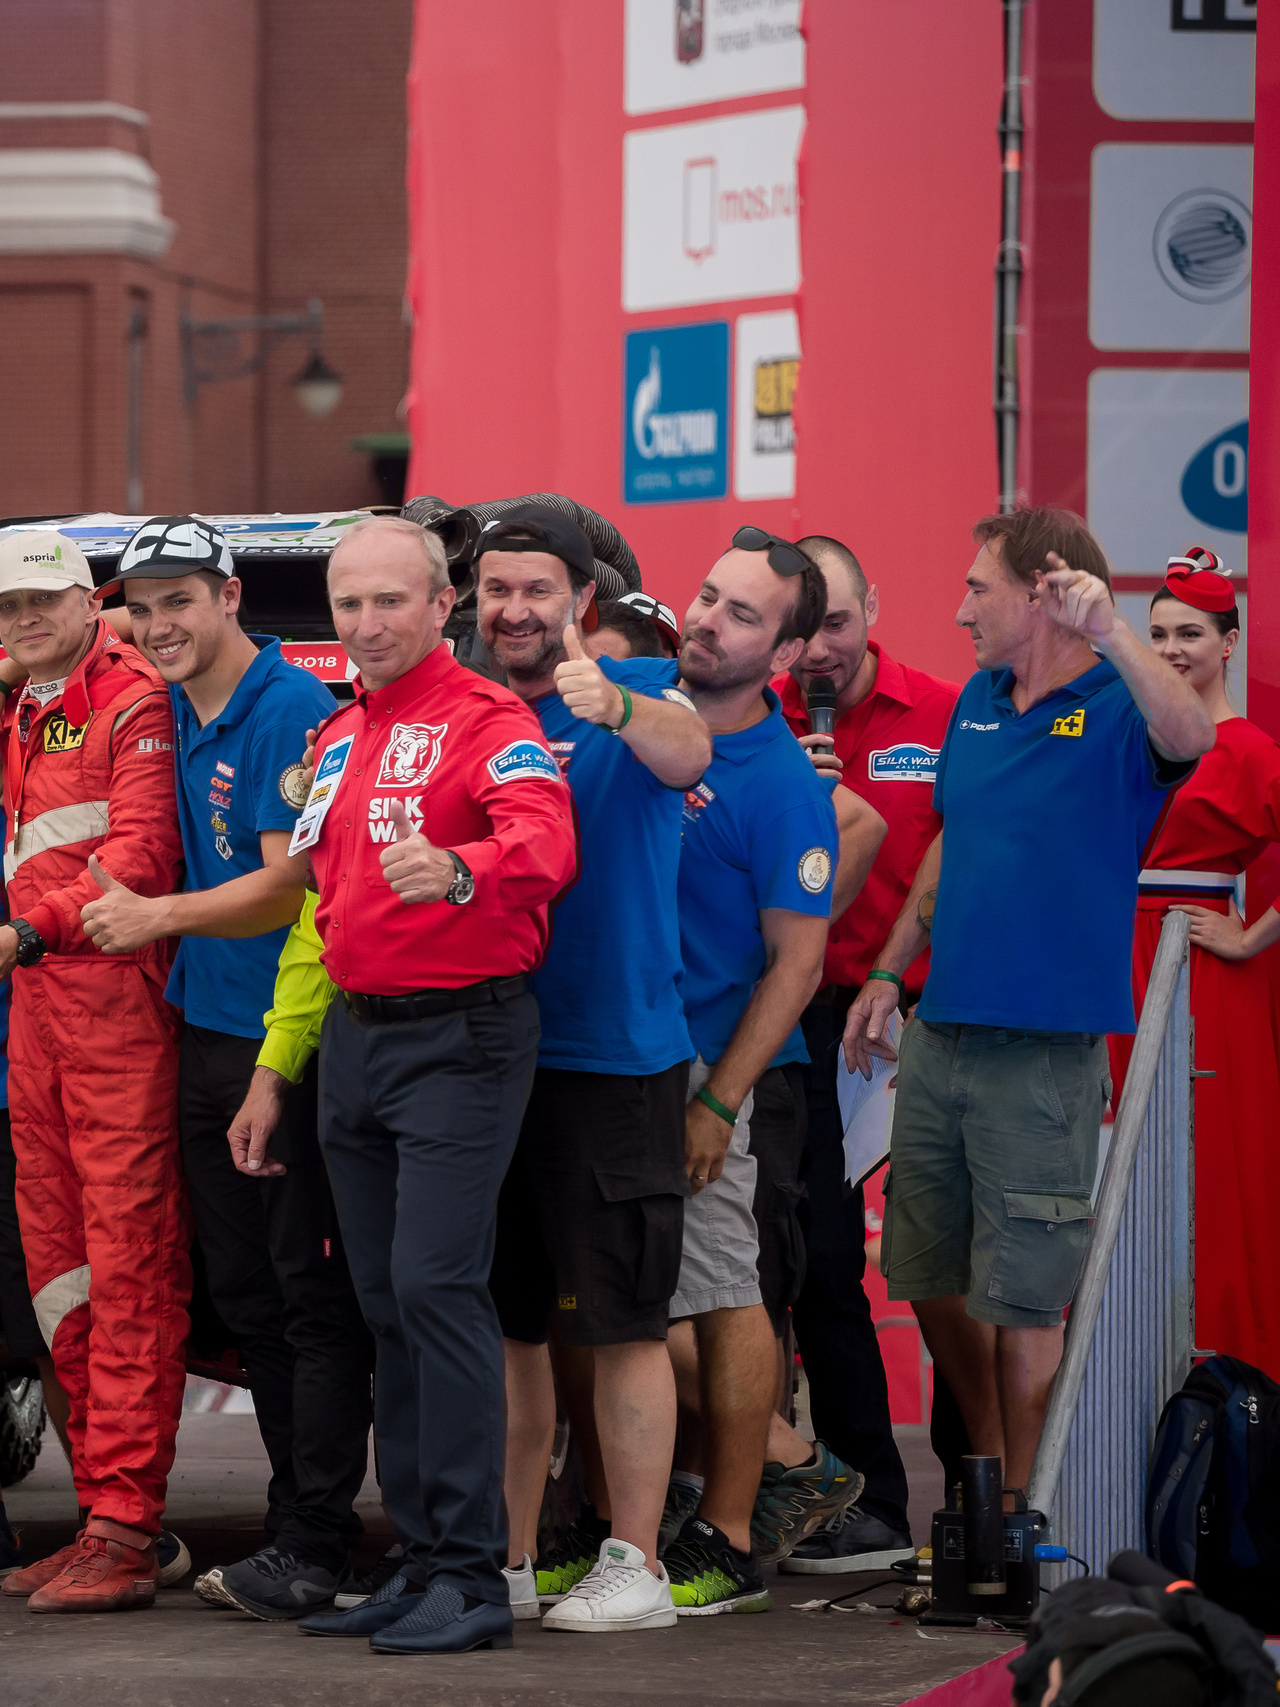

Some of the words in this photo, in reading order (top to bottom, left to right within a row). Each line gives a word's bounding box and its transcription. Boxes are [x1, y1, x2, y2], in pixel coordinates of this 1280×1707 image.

[23, 553, 56, 563] aspria
[39, 560, 66, 571] seeds
[293, 657, 337, 669] 2018
[498, 754, 532, 769] SILK
[876, 756, 909, 766] SILK
[911, 756, 940, 766] WAY
[210, 777, 233, 792] CST
[692, 1520, 714, 1536] FILA
